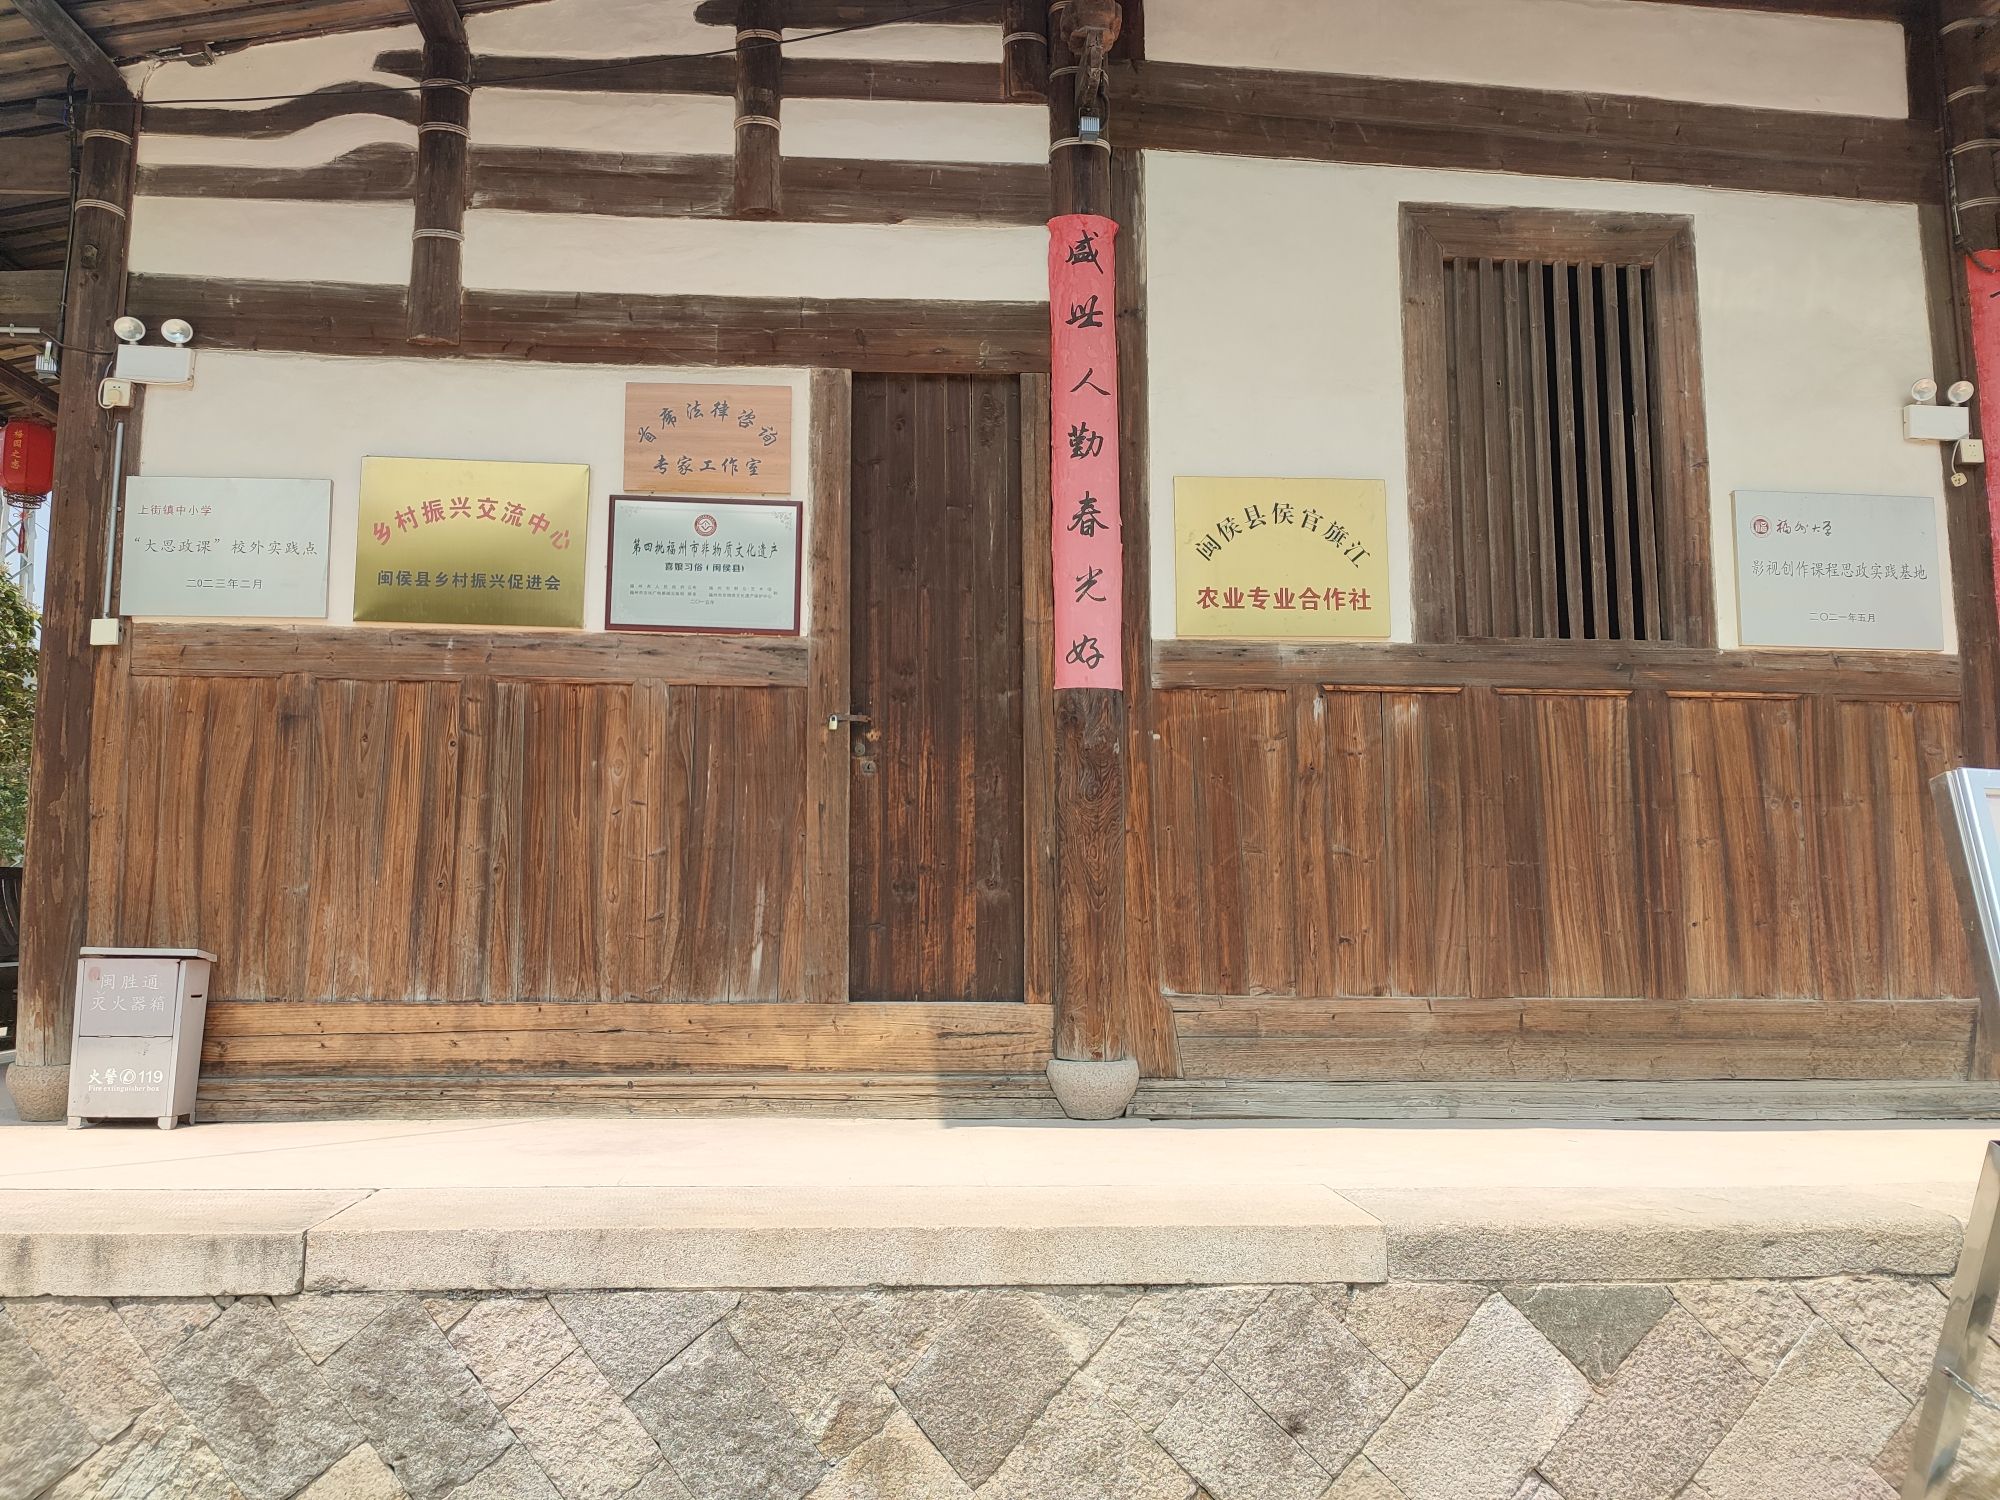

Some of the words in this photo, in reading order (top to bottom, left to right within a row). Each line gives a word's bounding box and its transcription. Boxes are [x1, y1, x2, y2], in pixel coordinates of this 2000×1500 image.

[1065, 229, 1111, 669] 盛世人勤春光好
[653, 455, 762, 476] 专家工作室
[137, 504, 212, 516] 上街镇中小学
[373, 496, 570, 550] 乡村振兴交流中心
[1776, 519, 1832, 537] 福州大学
[1194, 502, 1371, 568] 闽侯县侯官旗江
[632, 537, 778, 559] 第四批福州市非物质文化遗产
[1751, 559, 1928, 580] 影视创作课程思政实践基地
[377, 570, 561, 591] 闽侯县乡村振兴促进会
[1196, 586, 1372, 611] 农业专业合作社
[90, 994, 165, 1012] 灭火器箱
[88, 1068, 118, 1085] 火警
[138, 1070, 164, 1084] 119
[88, 1084, 102, 1092] Fire
